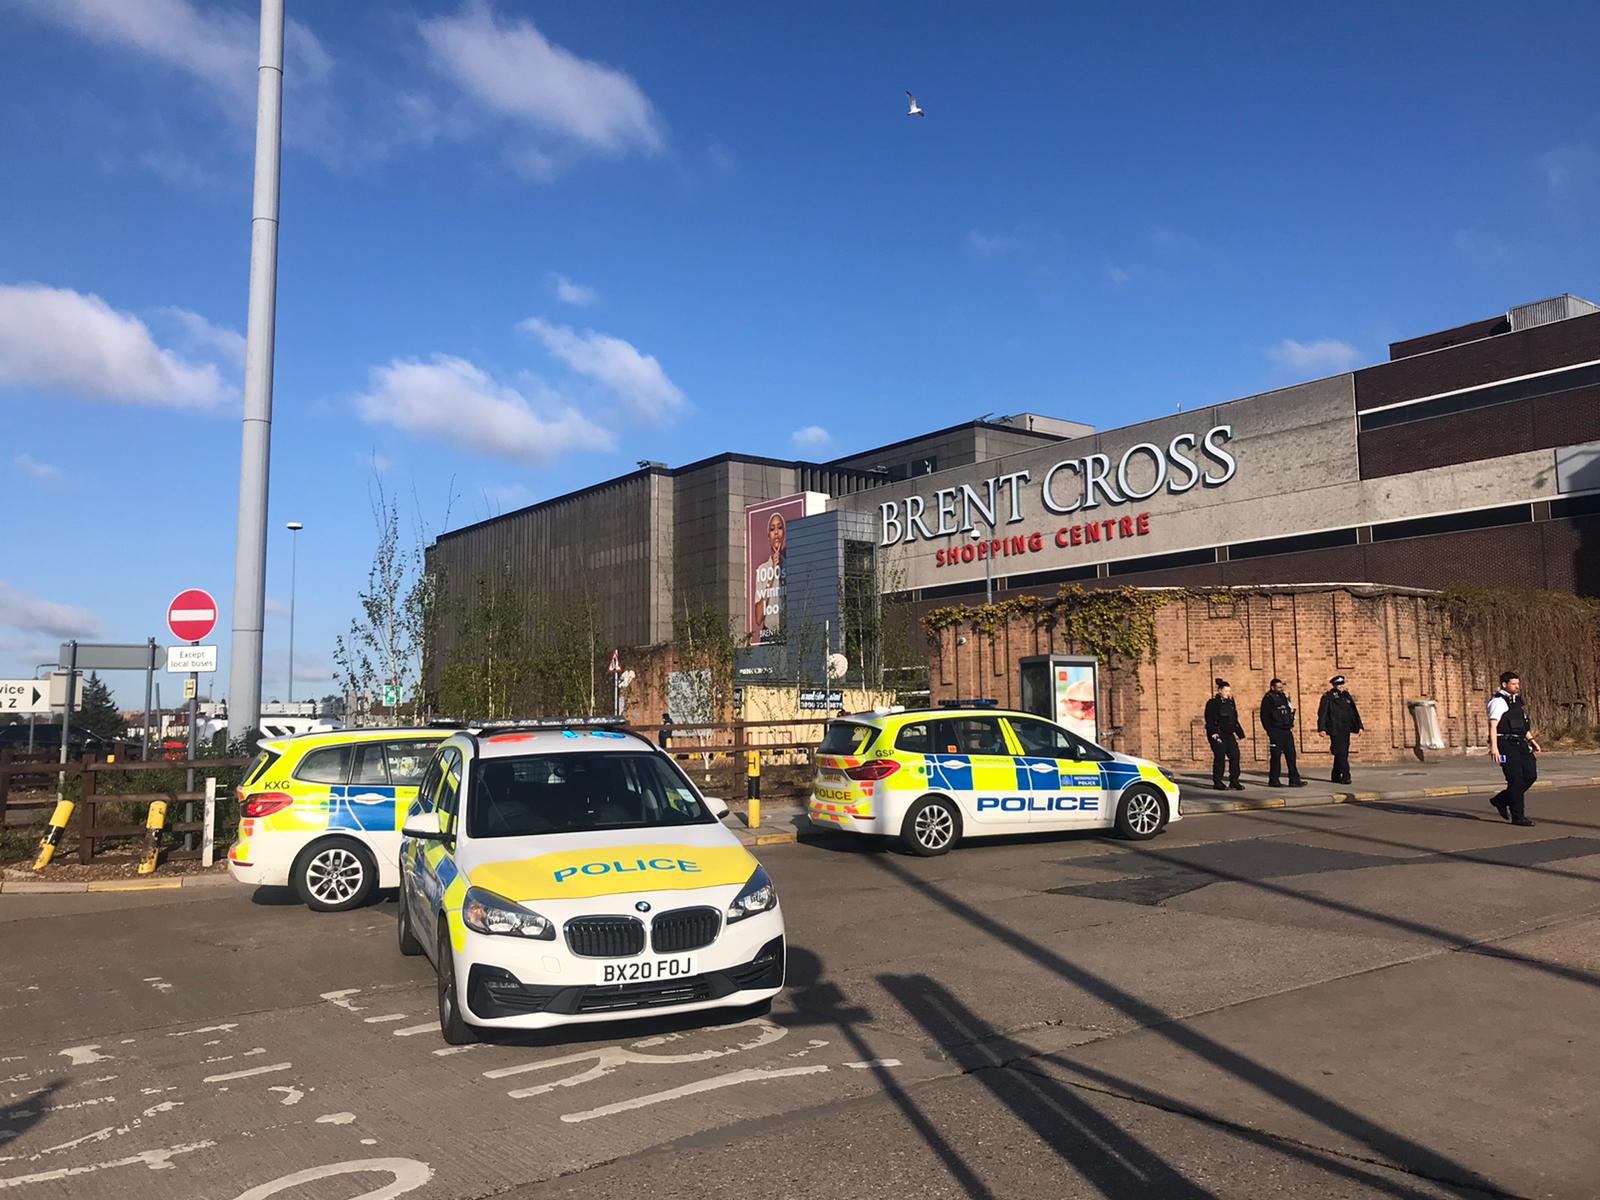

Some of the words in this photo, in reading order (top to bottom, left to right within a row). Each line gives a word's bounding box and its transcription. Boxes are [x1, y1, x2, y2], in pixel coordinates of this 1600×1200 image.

[879, 469, 1032, 548] BRENT
[1042, 424, 1237, 515] CROSS
[935, 531, 1044, 568] SHOPPING
[1055, 511, 1151, 549] CENTRE
[763, 600, 780, 615] loo
[180, 651, 205, 659] Except
[875, 749, 894, 758] GSP
[264, 780, 290, 790] KXG
[815, 786, 852, 800] POLICE
[976, 796, 1100, 812] POLICE
[553, 858, 703, 883] POLICE
[603, 961, 652, 982] BX20
[657, 957, 692, 977] FOJ
